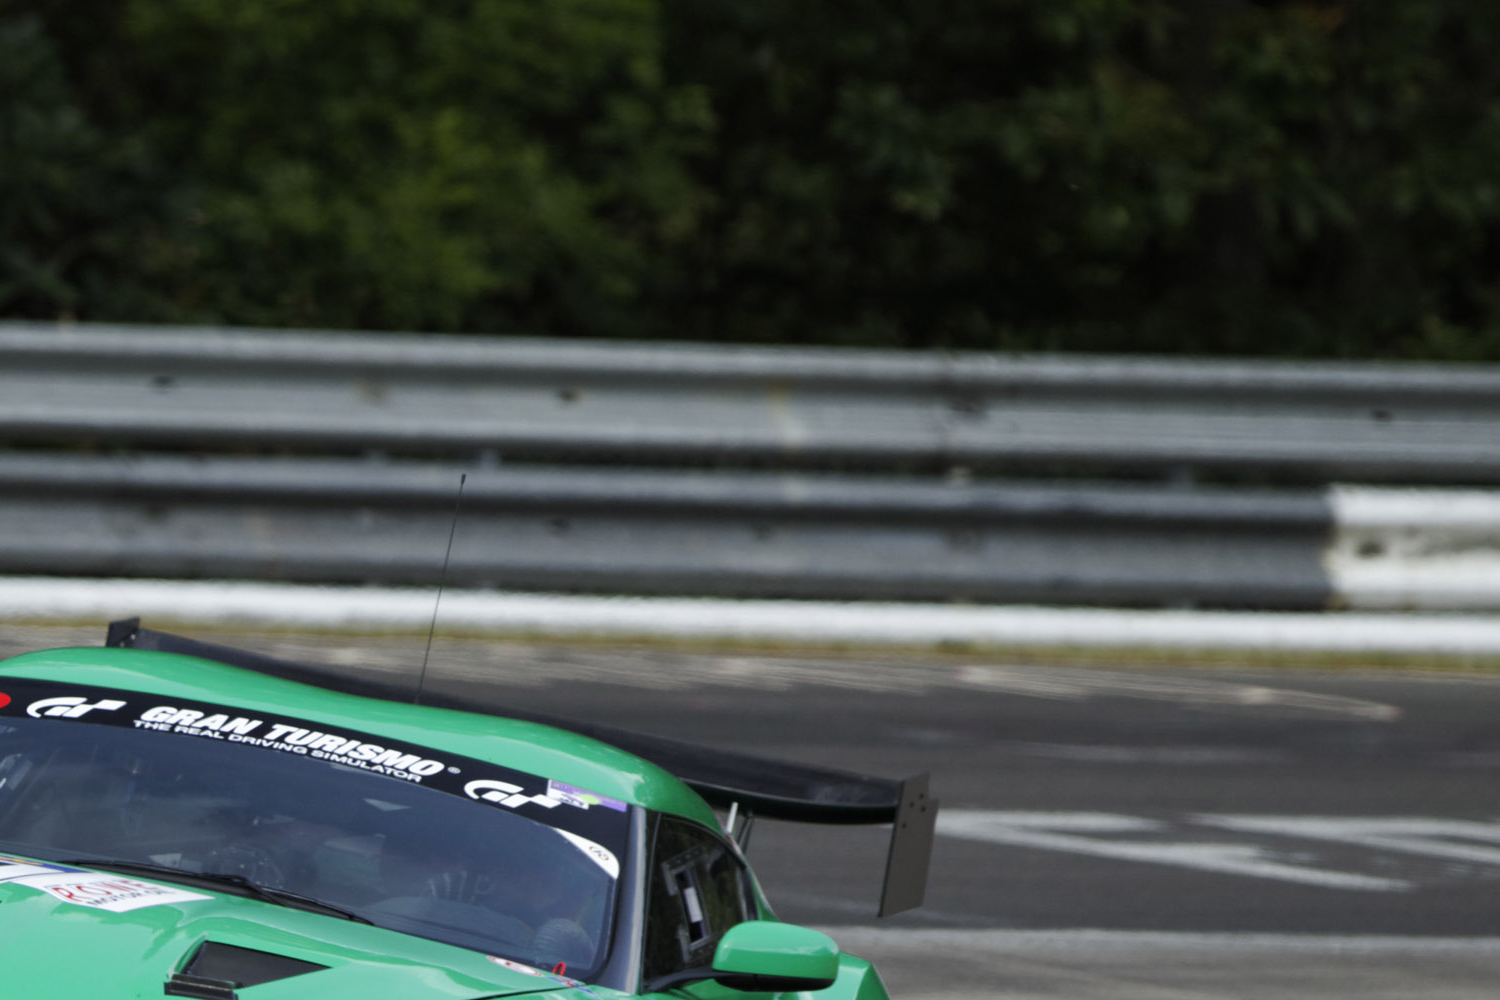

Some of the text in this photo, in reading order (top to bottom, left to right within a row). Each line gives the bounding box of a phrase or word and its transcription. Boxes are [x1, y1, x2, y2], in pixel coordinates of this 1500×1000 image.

[133, 720, 422, 783] THE REAL DRIVING SIMULATOR
[140, 705, 446, 777] GRAN TURISMO
